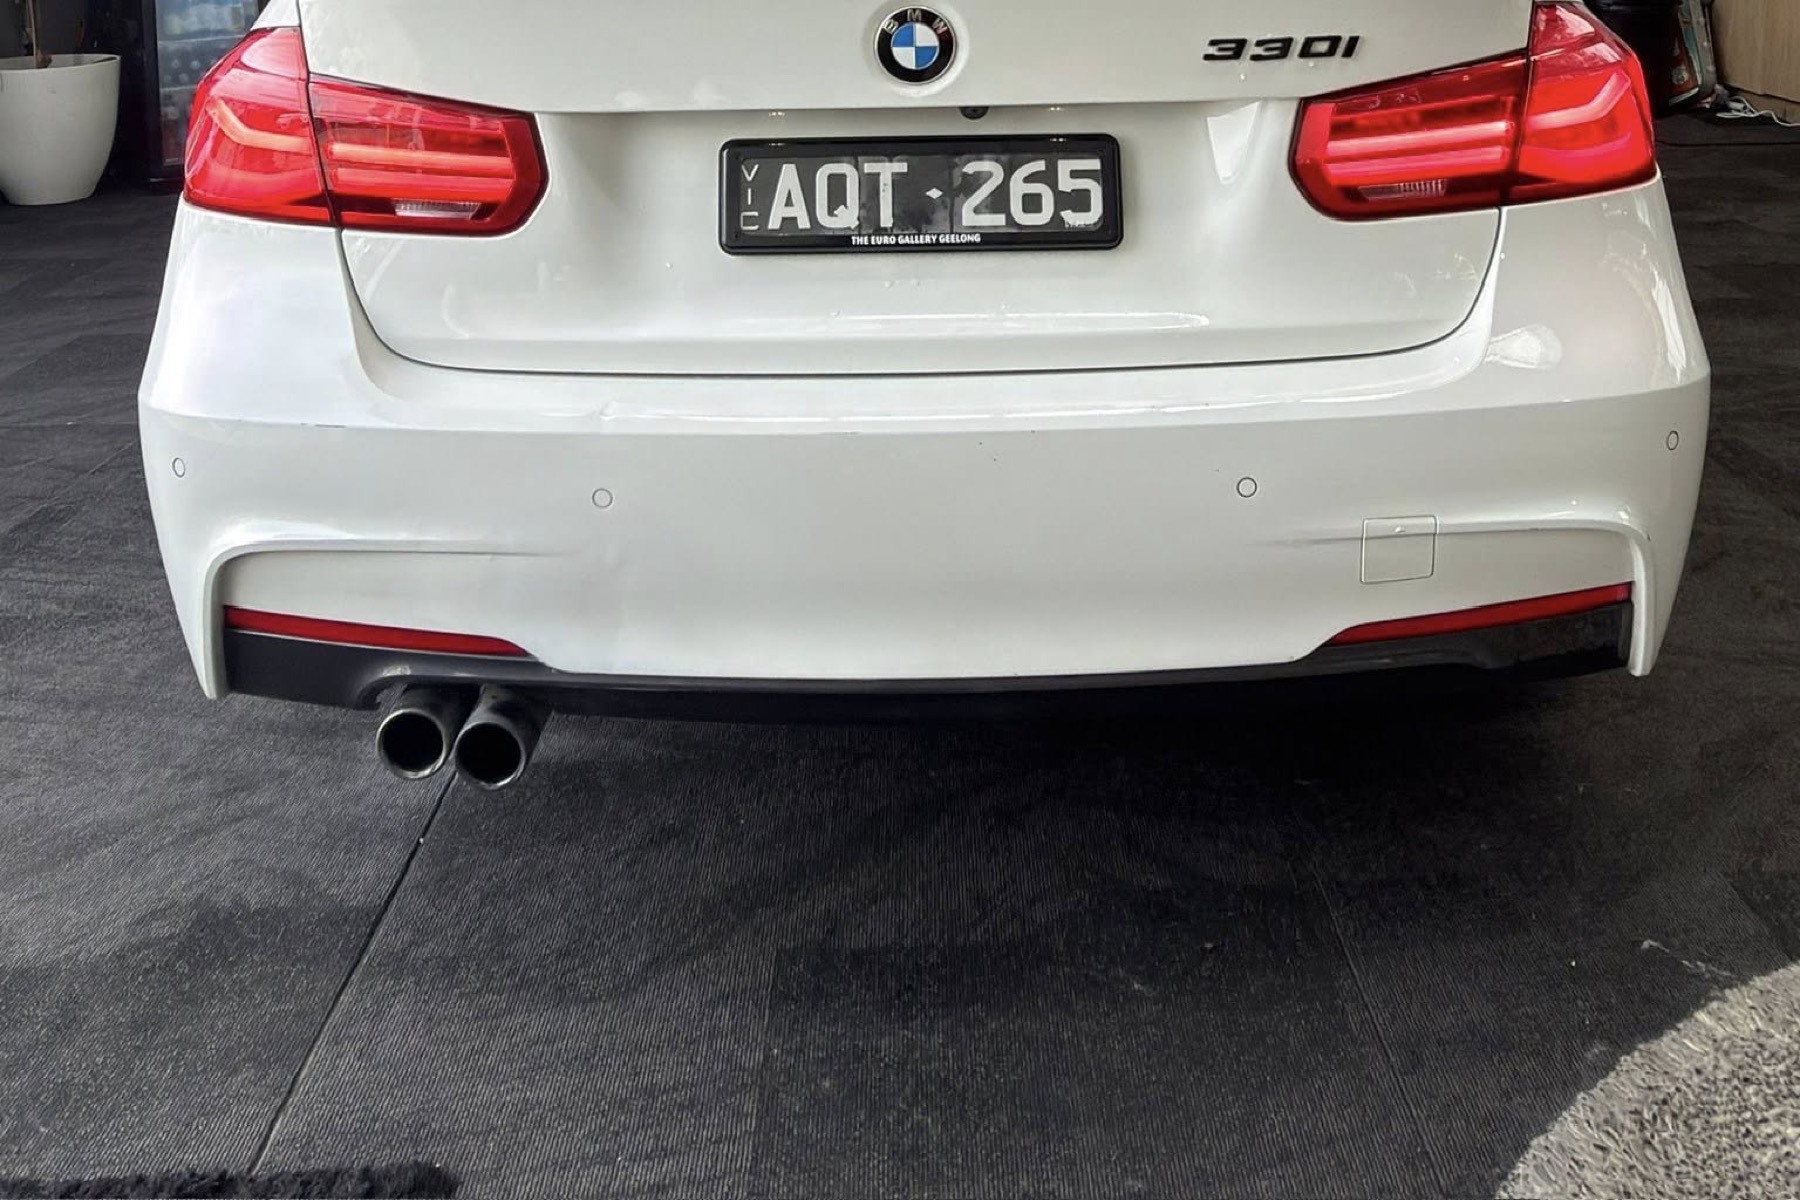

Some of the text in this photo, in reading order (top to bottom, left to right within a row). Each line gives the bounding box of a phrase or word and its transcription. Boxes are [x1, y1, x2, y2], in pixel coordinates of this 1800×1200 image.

[882, 8, 949, 35] BMW
[851, 233, 981, 245] THE EURO GALLERY GEELONG
